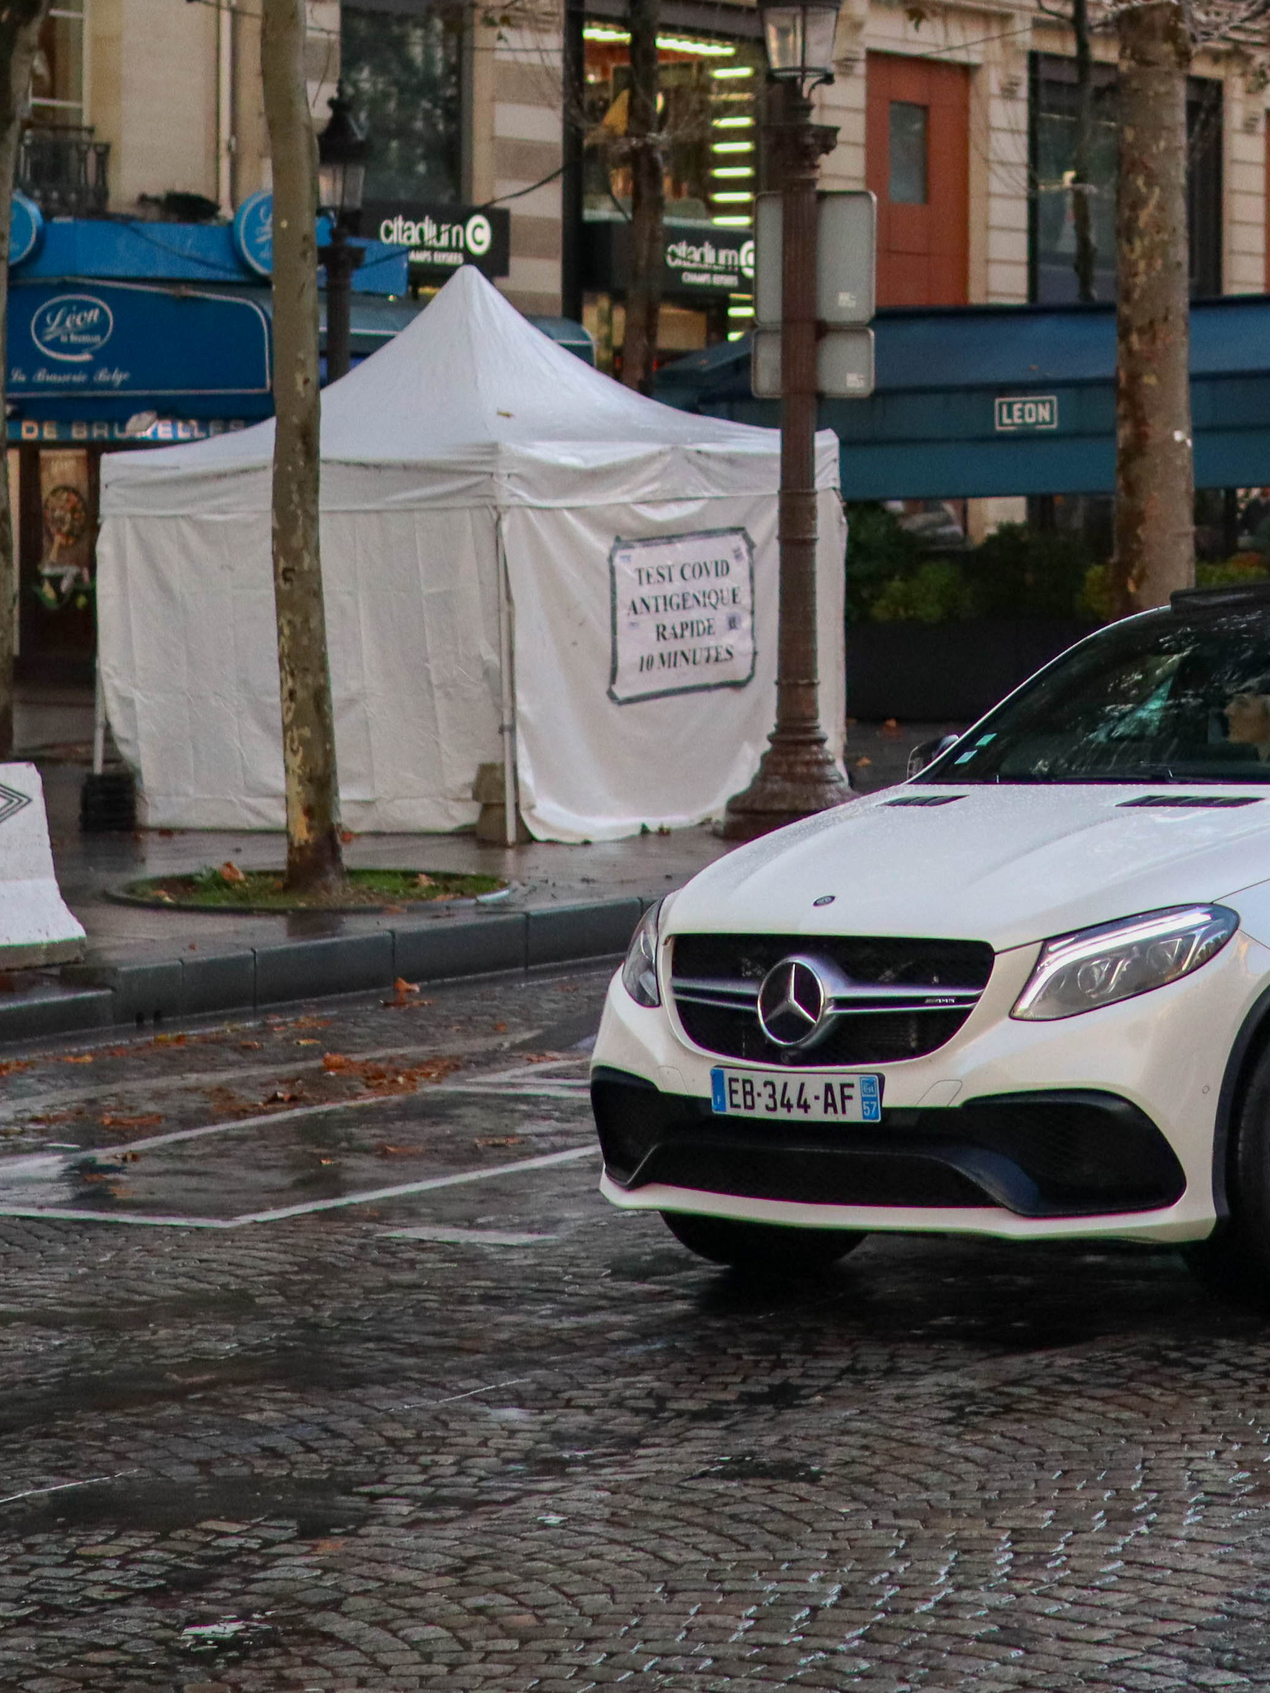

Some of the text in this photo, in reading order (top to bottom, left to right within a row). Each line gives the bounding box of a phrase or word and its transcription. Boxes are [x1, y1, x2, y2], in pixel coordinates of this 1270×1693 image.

[380, 214, 464, 248] citadium
[667, 240, 738, 271] citadium
[43, 305, 100, 341] Léon
[1002, 402, 1050, 423] LEON
[21, 419, 58, 439] DE
[635, 559, 730, 586] TEST COVID
[627, 587, 741, 616] ANTIGENIQUE
[655, 618, 716, 642] RAPIDE
[638, 644, 735, 672] 10 MINUTES
[728, 1077, 855, 1115] EB-344-AF
[862, 1101, 877, 1117] 57
